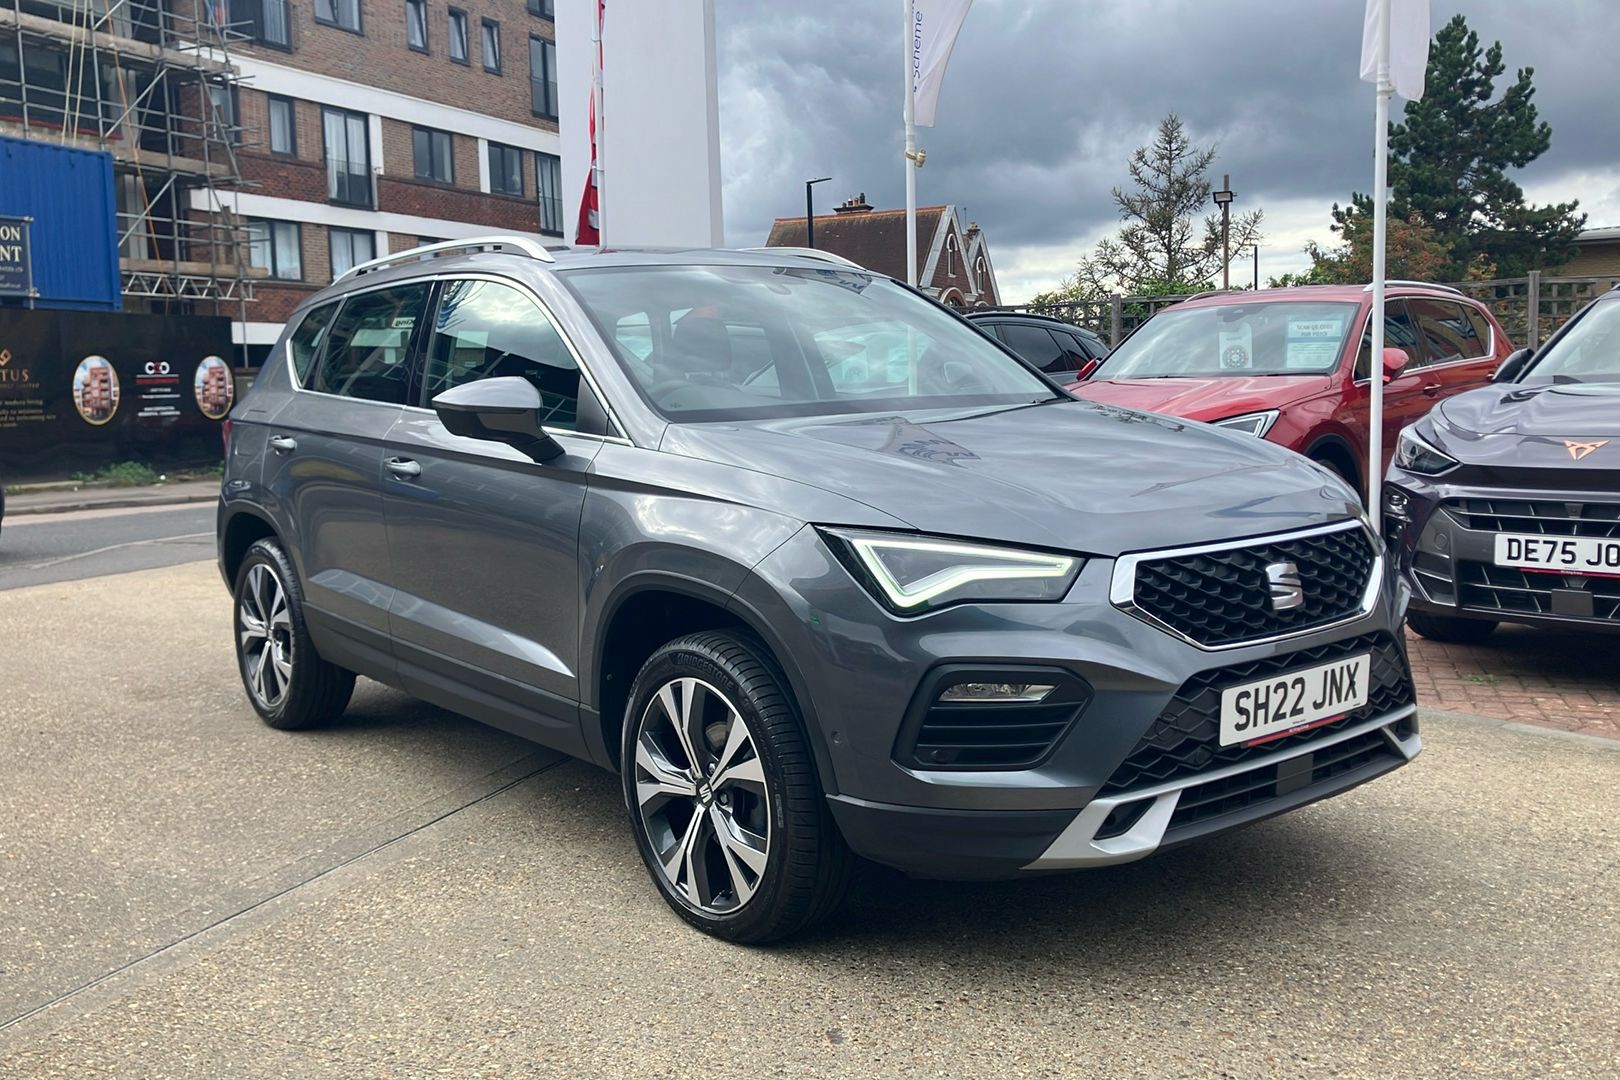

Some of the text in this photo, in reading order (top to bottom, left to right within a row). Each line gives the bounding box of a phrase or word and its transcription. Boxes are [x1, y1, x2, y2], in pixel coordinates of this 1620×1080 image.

[1507, 538, 1577, 564] DE75
[677, 652, 734, 690] BRIDGESTONE
[1234, 662, 1360, 732] SH22 JNX
